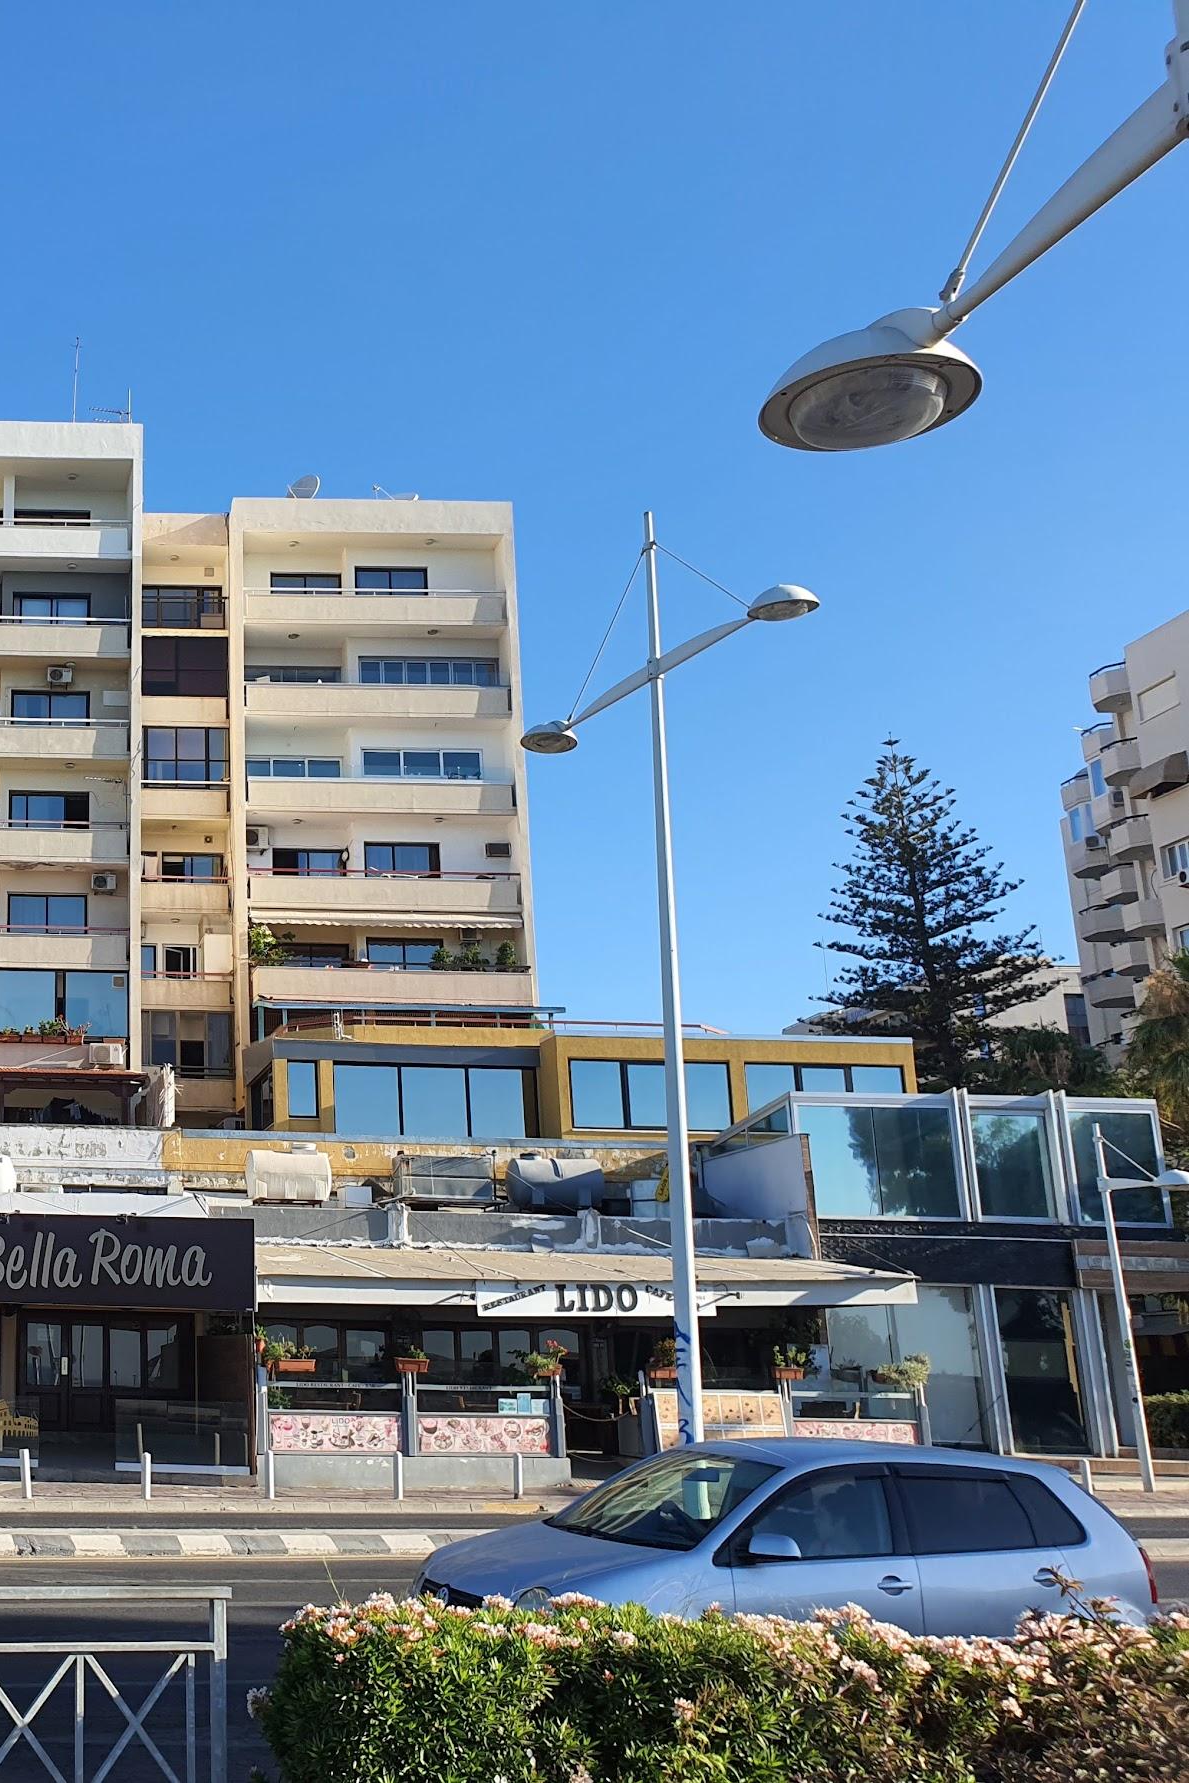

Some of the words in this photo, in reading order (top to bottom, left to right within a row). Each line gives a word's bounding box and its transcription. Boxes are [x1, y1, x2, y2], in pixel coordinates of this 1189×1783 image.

[88, 1228, 212, 1289] Roma
[481, 1284, 547, 1311] RESTAURANT
[554, 1283, 639, 1313] LIDO
